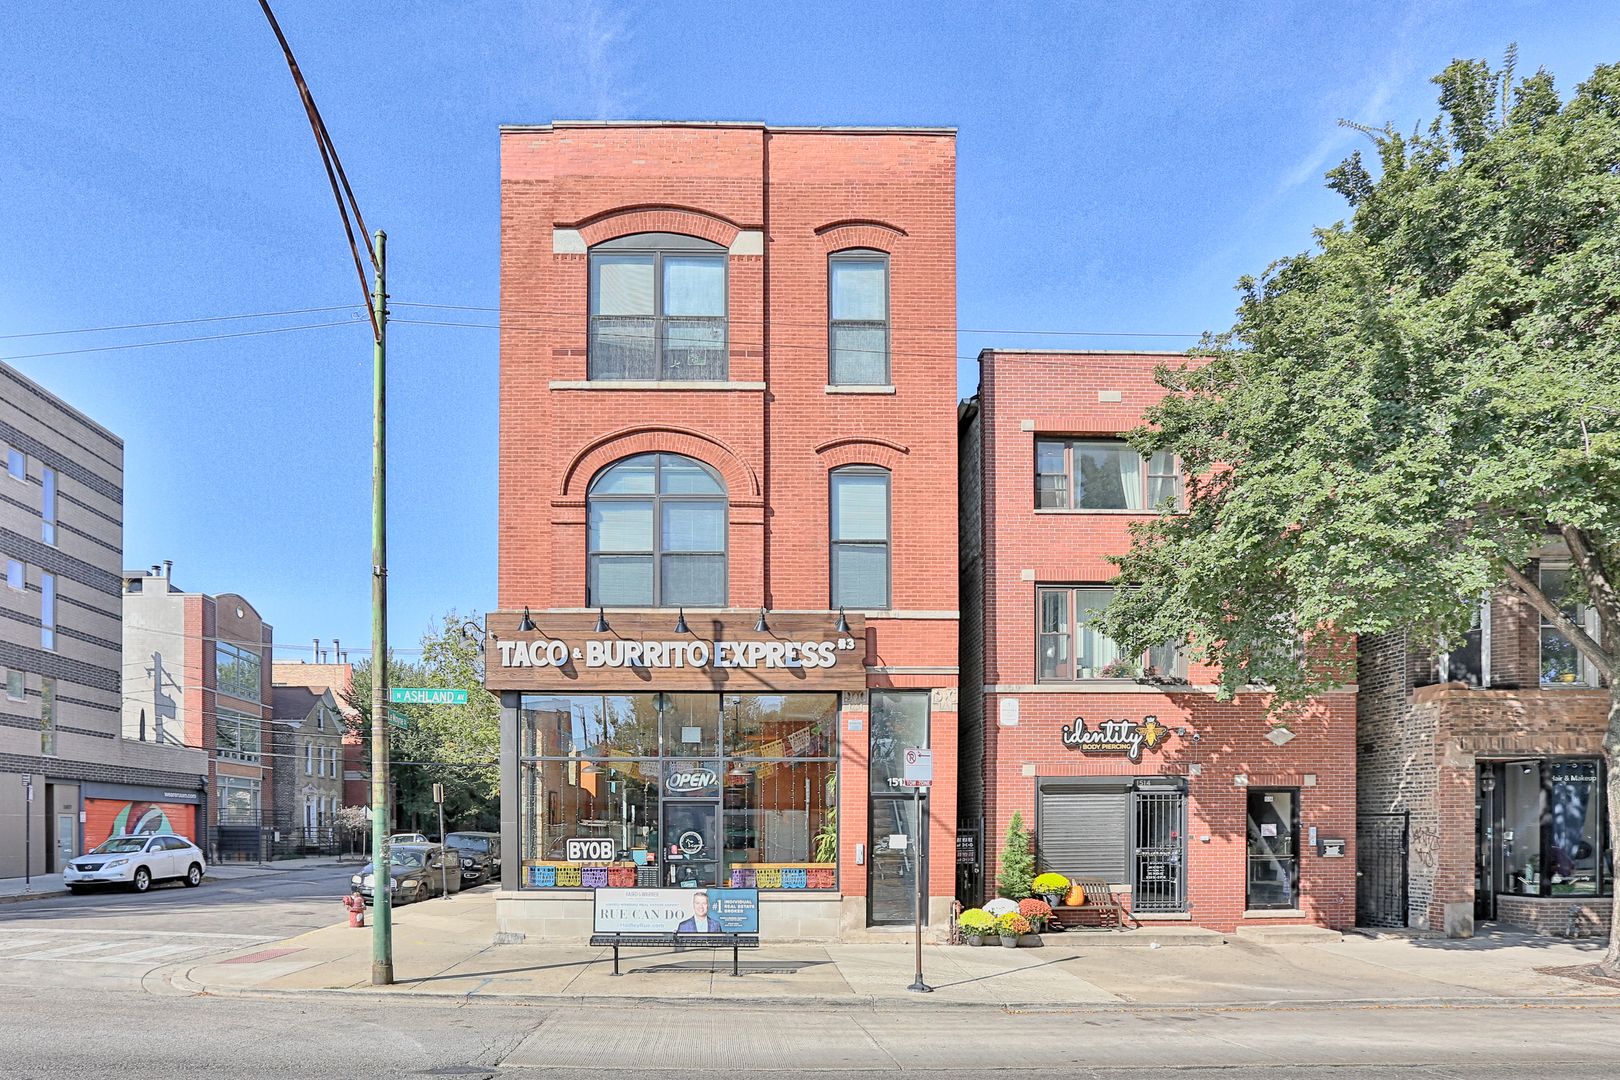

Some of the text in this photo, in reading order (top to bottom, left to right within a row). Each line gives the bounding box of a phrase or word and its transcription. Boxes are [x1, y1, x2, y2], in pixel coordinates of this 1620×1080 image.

[496, 638, 855, 668] TACO & BURRITO EXPRESS #3
[403, 690, 455, 702] ASHLAND
[1063, 718, 1143, 758] identity
[669, 772, 711, 788] OPEN
[1570, 774, 1597, 783] Makeup
[569, 841, 612, 859] BYOB
[600, 908, 685, 920] RUE CAN DO
[712, 899, 723, 914] #1
